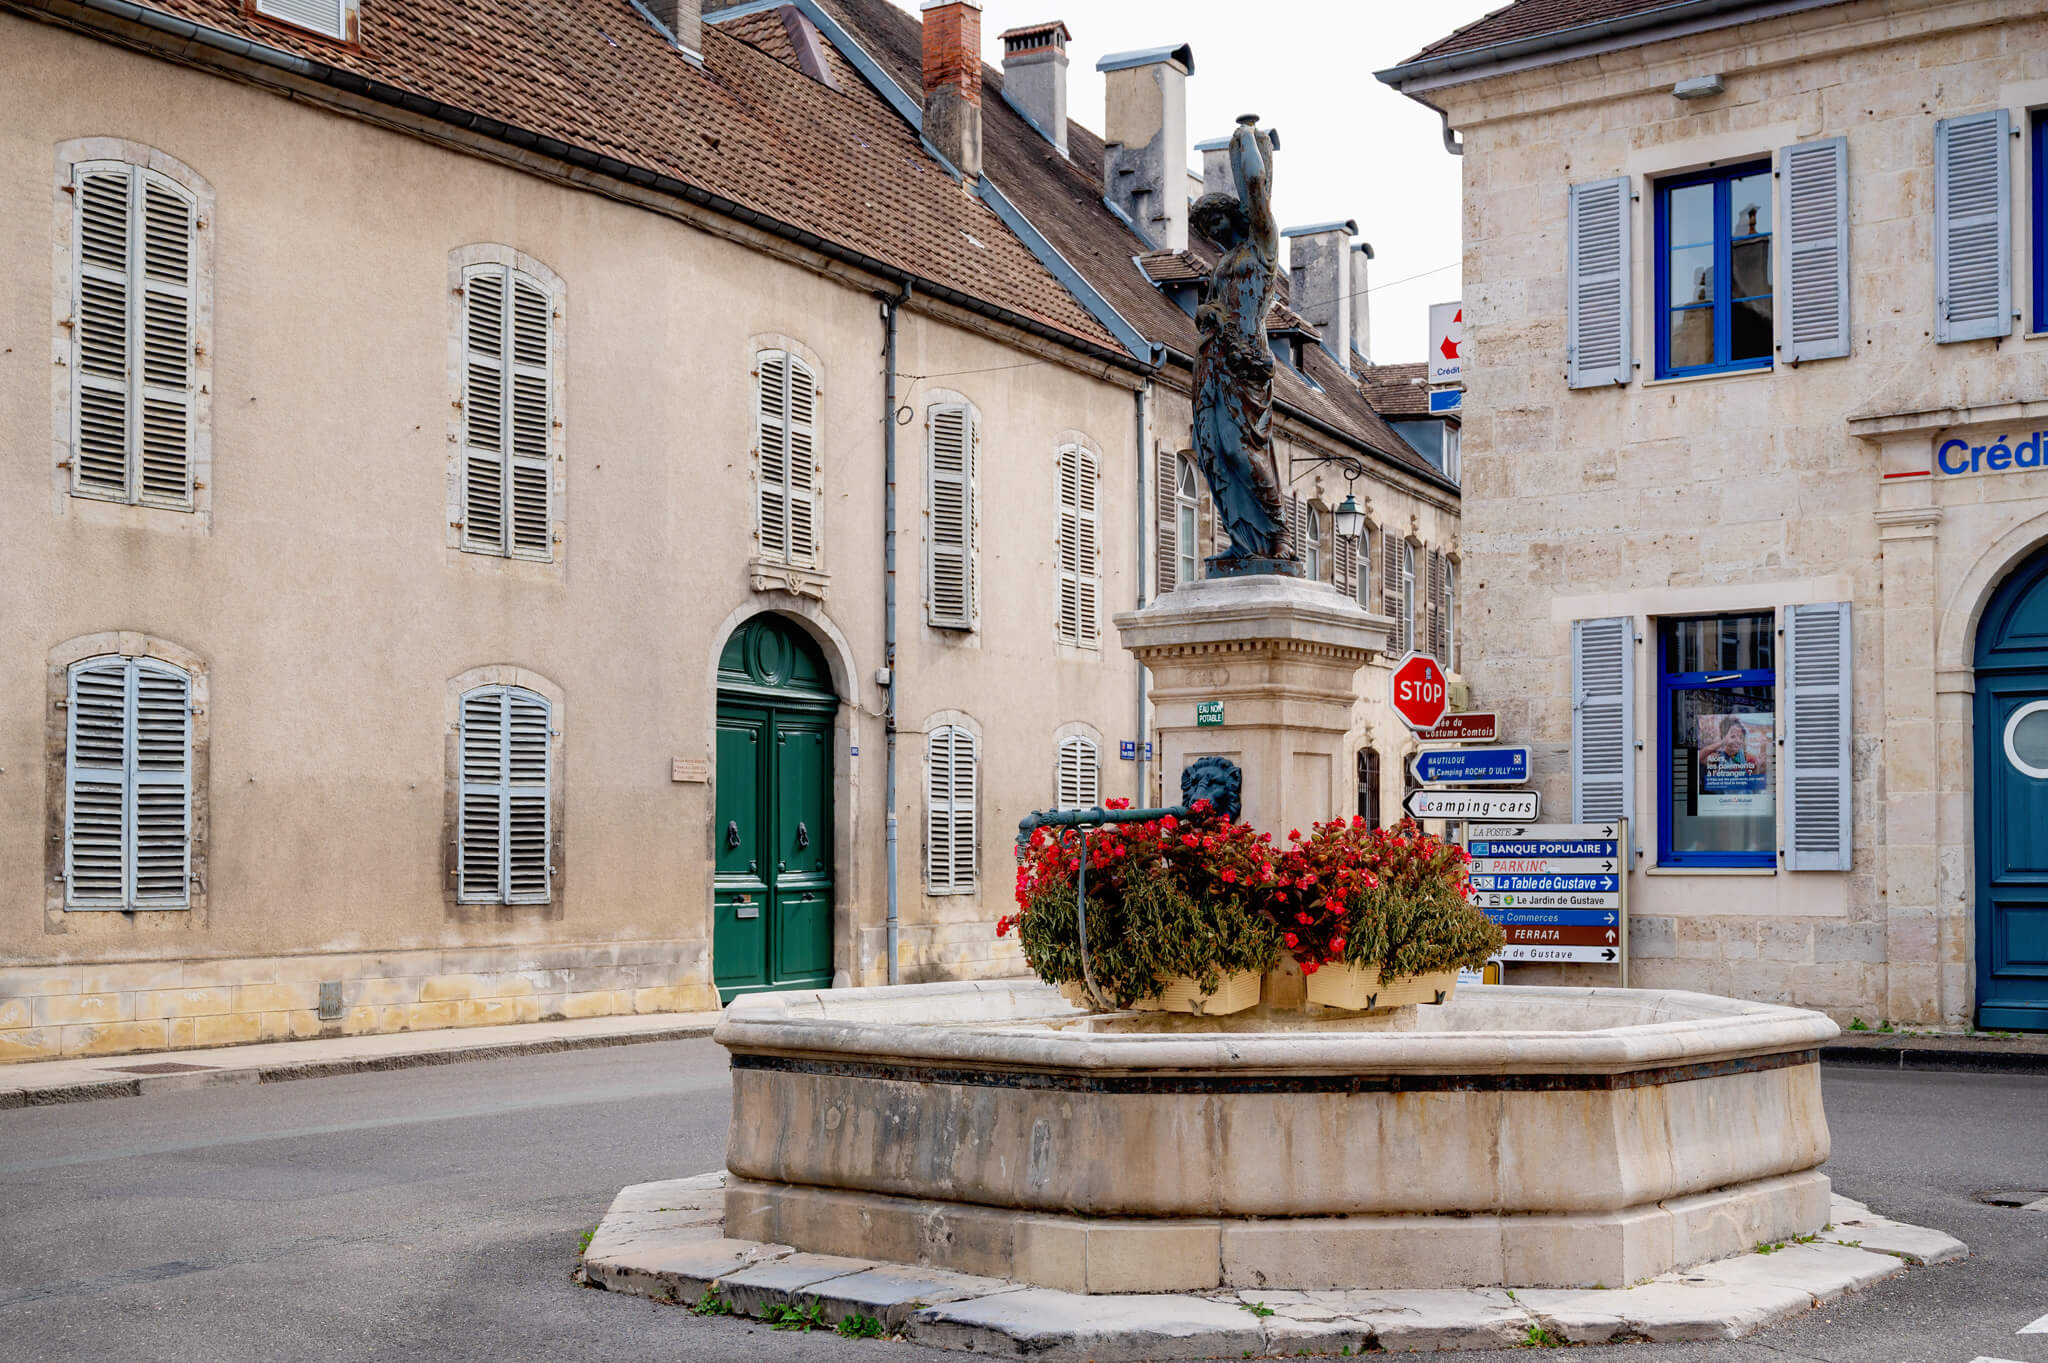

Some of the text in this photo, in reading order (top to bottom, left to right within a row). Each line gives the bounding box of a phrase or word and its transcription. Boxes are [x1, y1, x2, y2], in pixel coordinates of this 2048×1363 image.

[1400, 680, 1442, 703] STOP
[1200, 714, 1222, 722] POTABLE
[1453, 717, 1463, 727] du
[1425, 726, 1493, 738] Costume Comtois
[1436, 768, 1463, 777] Camping
[1465, 767, 1488, 776] ROCHE
[1427, 798, 1532, 816] camping-cars
[1473, 828, 1512, 837] LA POSTE
[1491, 844, 1601, 855] BANQUE POPULAIRE
[1497, 877, 1597, 889] La Table de Gustave
[1517, 895, 1605, 905] Le Jardin de Gustave
[1506, 912, 1559, 922] Commerces
[1514, 929, 1560, 940] FERRATA
[1512, 949, 1525, 958] de
[1530, 949, 1573, 959] Gustave
